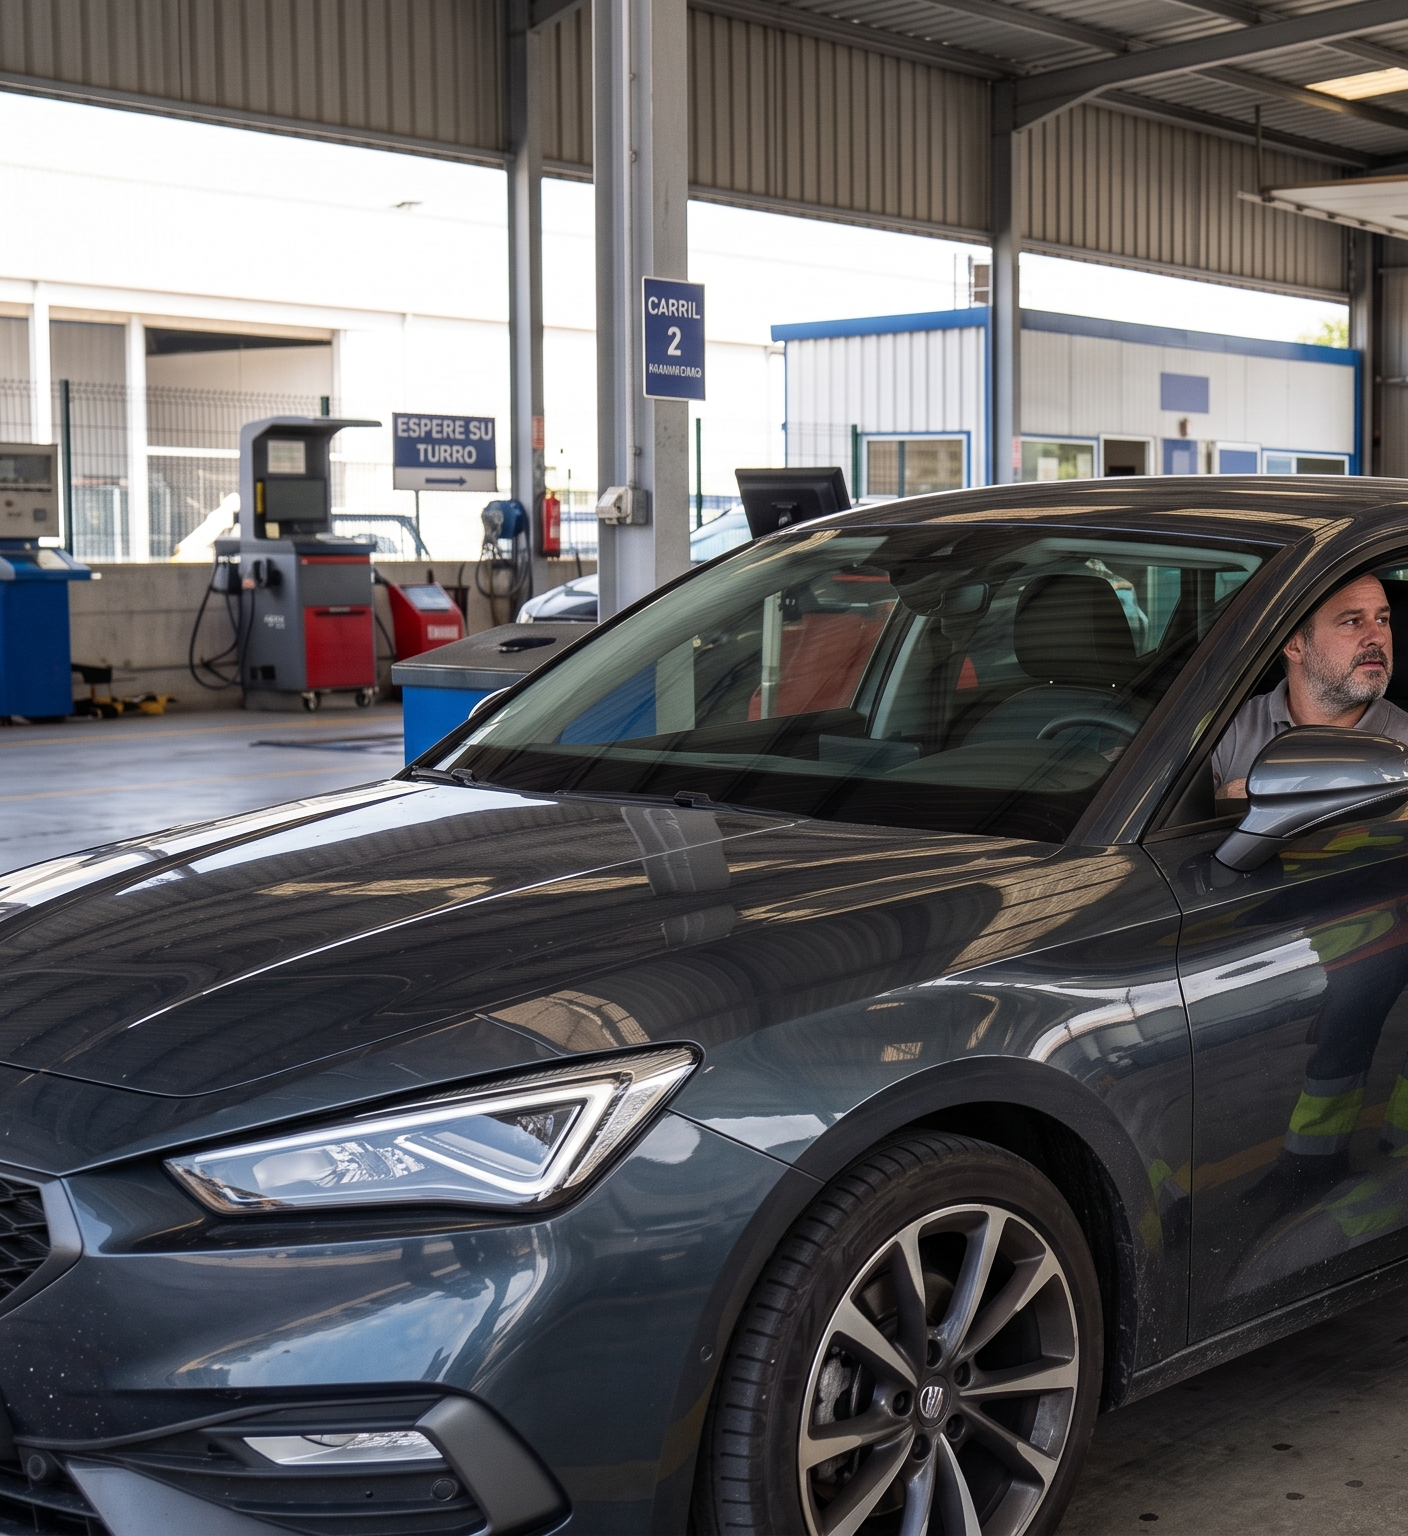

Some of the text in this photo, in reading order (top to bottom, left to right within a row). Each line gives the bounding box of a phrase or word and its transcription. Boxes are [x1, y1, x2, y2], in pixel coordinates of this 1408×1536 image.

[648, 296, 701, 319] CARRIL
[667, 326, 682, 356] 2
[397, 417, 493, 441] ESPERE SU
[416, 443, 477, 464] TURRO
